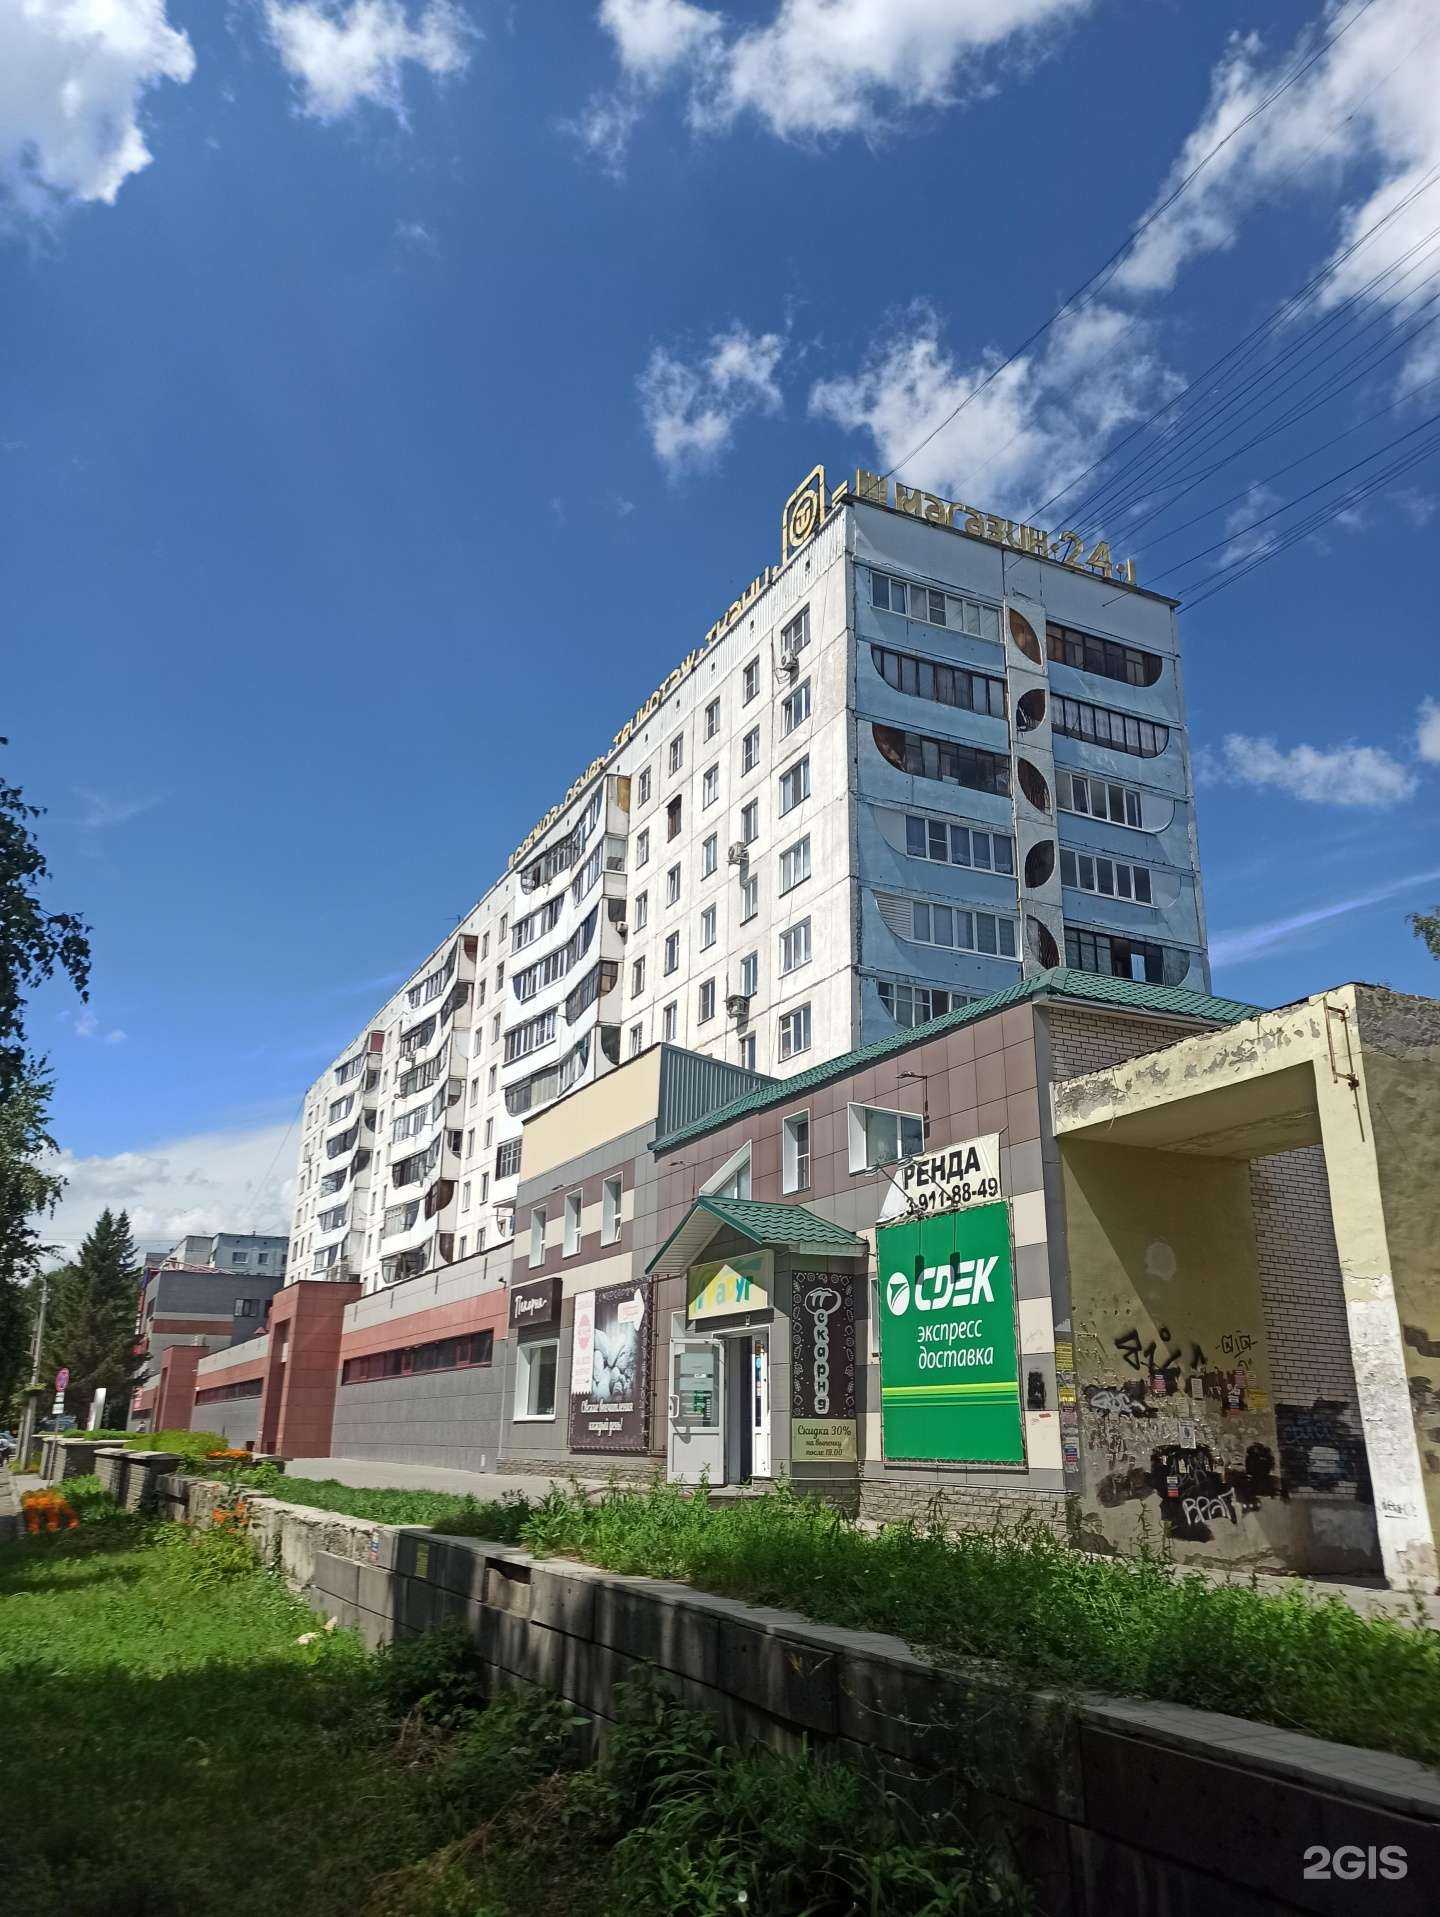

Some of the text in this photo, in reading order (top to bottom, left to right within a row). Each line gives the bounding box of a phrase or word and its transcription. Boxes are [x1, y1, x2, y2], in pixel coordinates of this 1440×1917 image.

[896, 482, 1112, 579] магазин 24
[917, 1319, 982, 1345] экспресс
[807, 1289, 836, 1412] Пекарня
[918, 1345, 994, 1369] доставка
[797, 1424, 852, 1439] Скидка 30%
